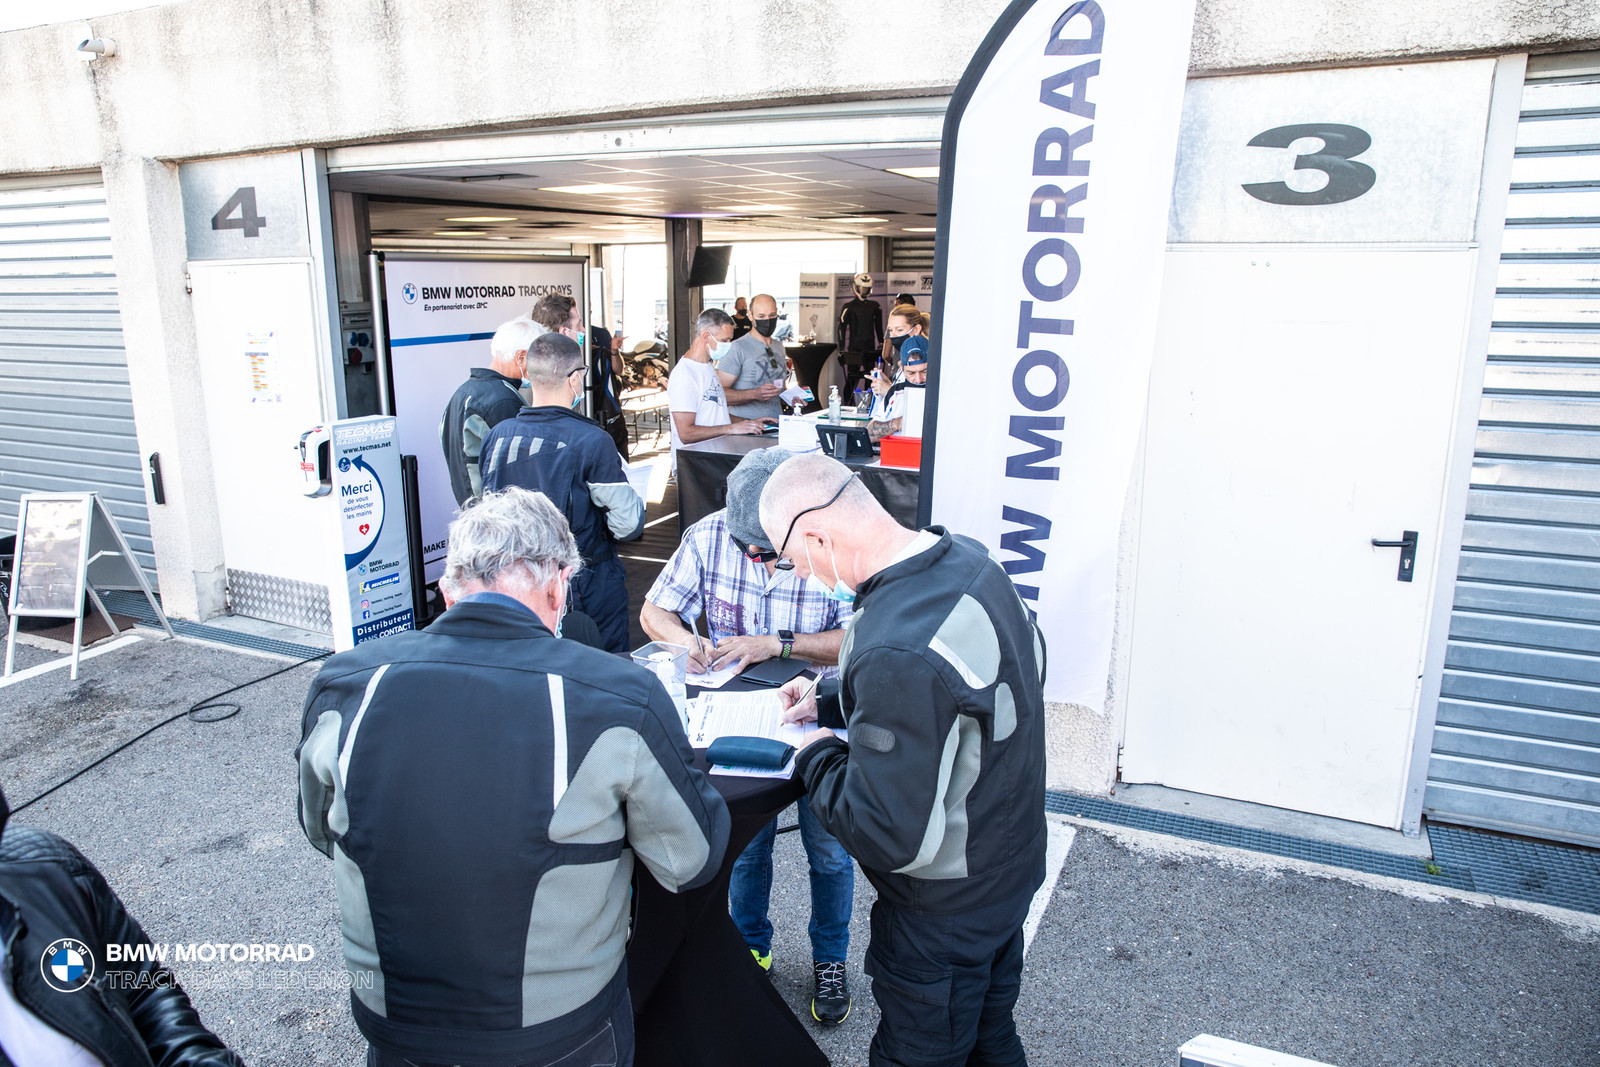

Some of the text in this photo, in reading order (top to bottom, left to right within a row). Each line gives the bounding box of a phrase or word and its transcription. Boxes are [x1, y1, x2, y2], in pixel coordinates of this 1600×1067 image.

[1241, 123, 1376, 205] 3
[211, 187, 266, 238] 4
[1005, 0, 1105, 481] MOTORRAD
[422, 287, 451, 299] BMW
[455, 286, 516, 298] MOTORRAD
[518, 285, 549, 297] TRACK
[433, 303, 462, 312] partenariat
[335, 420, 395, 439] TECMAS
[336, 433, 392, 446] RACING TEAM
[342, 441, 392, 454] www.tecmas.net
[341, 480, 373, 497] Merci
[424, 540, 446, 554] MAKE
[369, 559, 383, 568] BMW
[370, 561, 400, 573] MOTORRAD
[371, 576, 399, 588] MICHELIN
[357, 613, 411, 636] Distributeur
[379, 622, 411, 639] CONTACT
